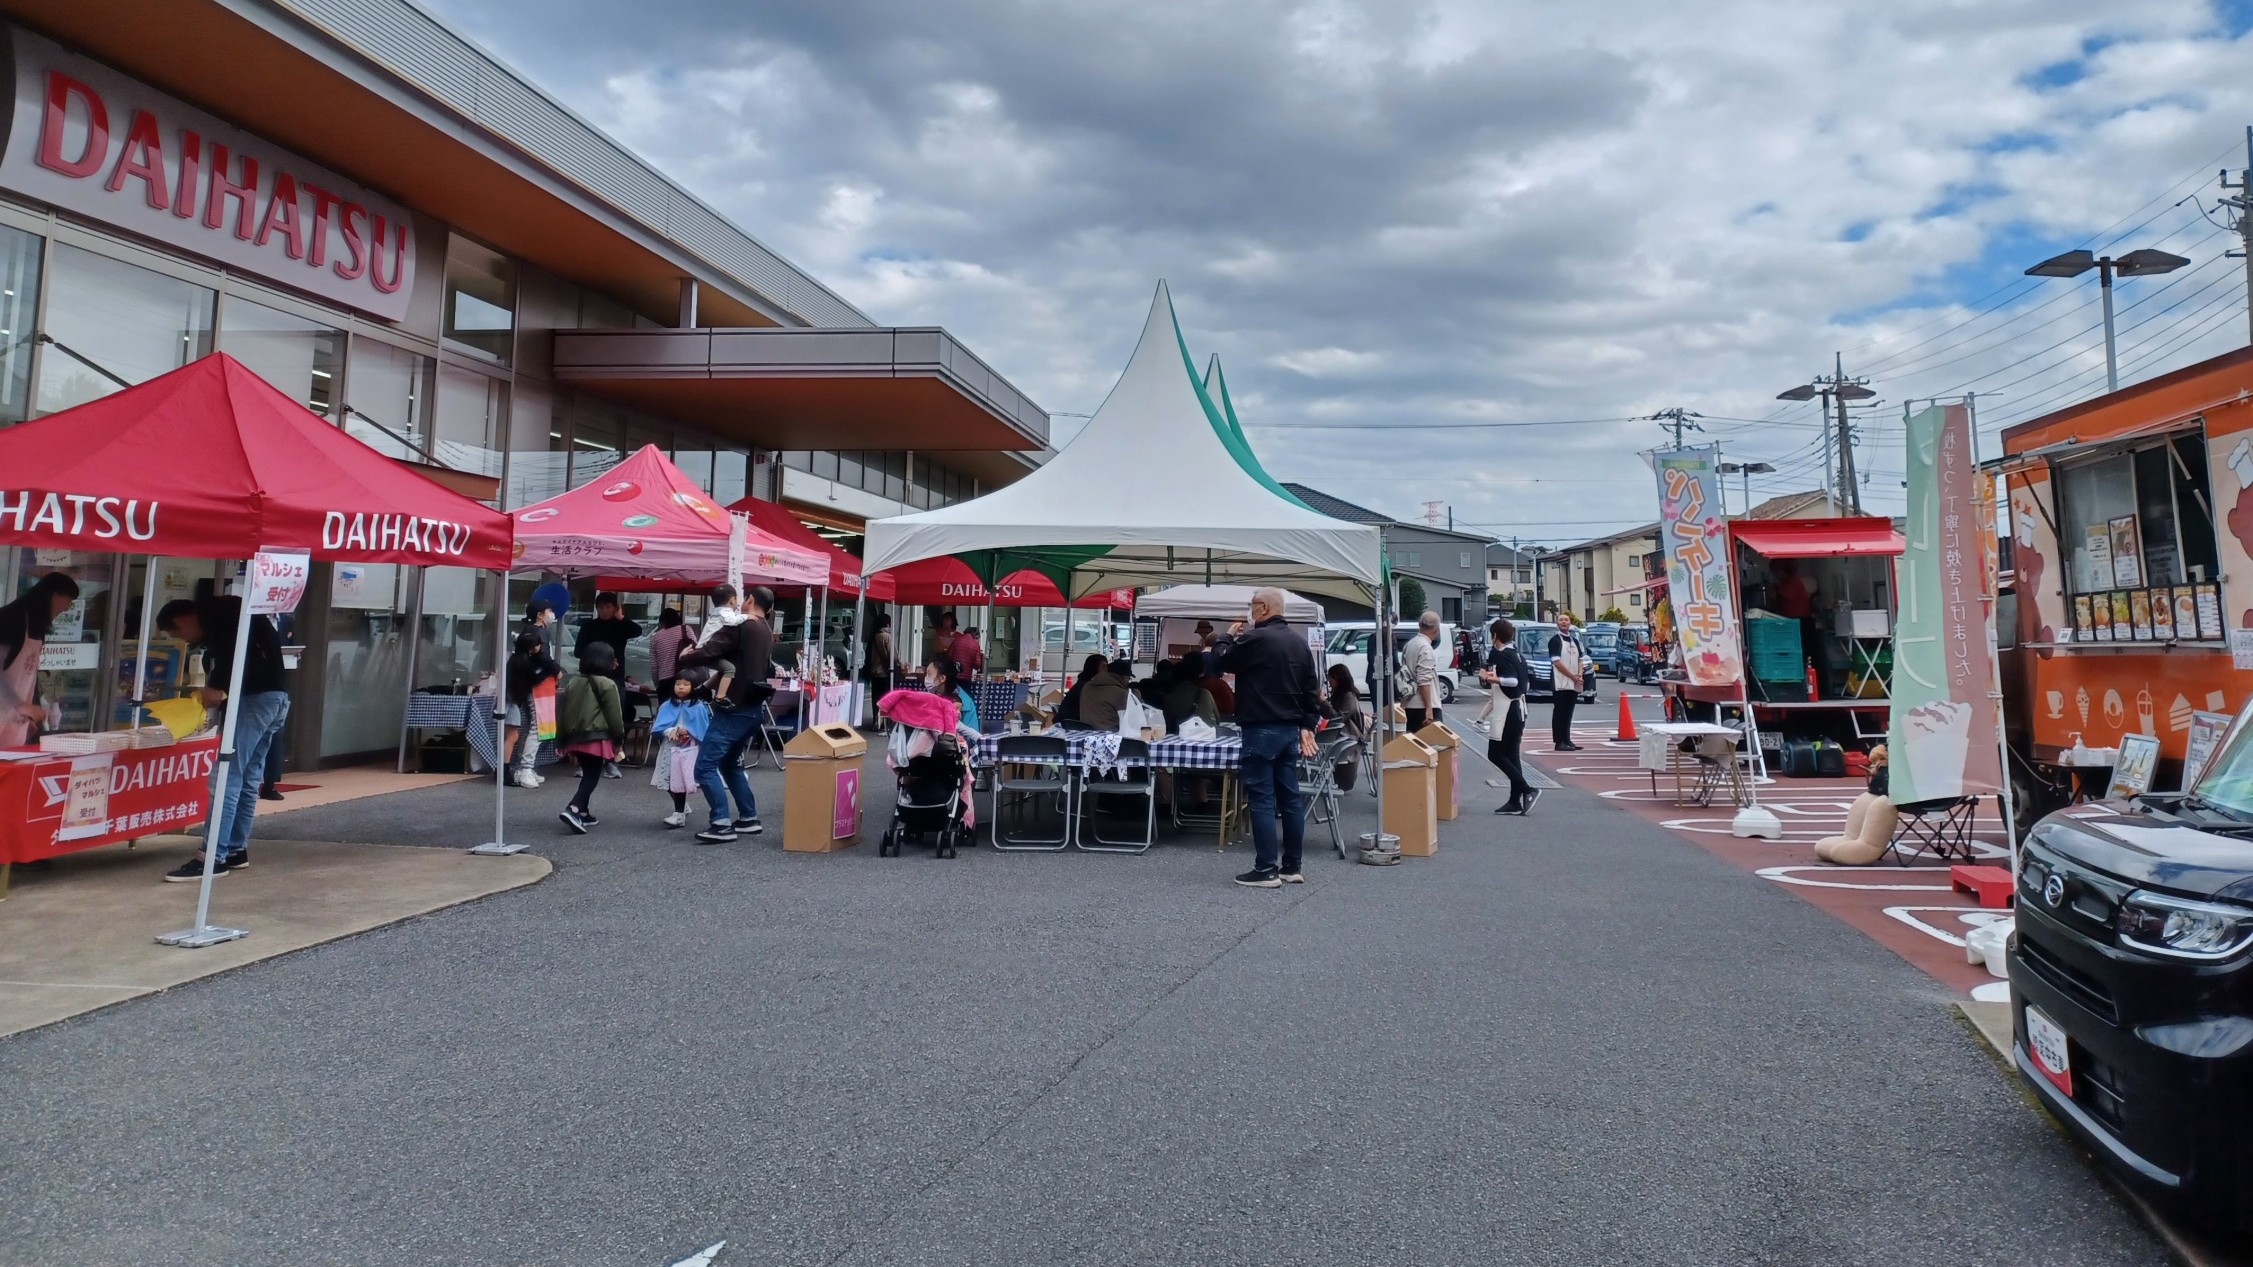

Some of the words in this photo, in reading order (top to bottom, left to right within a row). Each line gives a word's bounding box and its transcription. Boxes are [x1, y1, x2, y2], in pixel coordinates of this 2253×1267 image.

[36, 69, 407, 294] DAIHATSU
[322, 511, 471, 556] DAIHATSU
[260, 562, 303, 578] マルシェ
[266, 586, 290, 602] 受付
[109, 749, 218, 795] DAIHATS
[73, 776, 102, 790] ダイハツ
[81, 788, 105, 800] マルシェ
[79, 807, 97, 818] 受付
